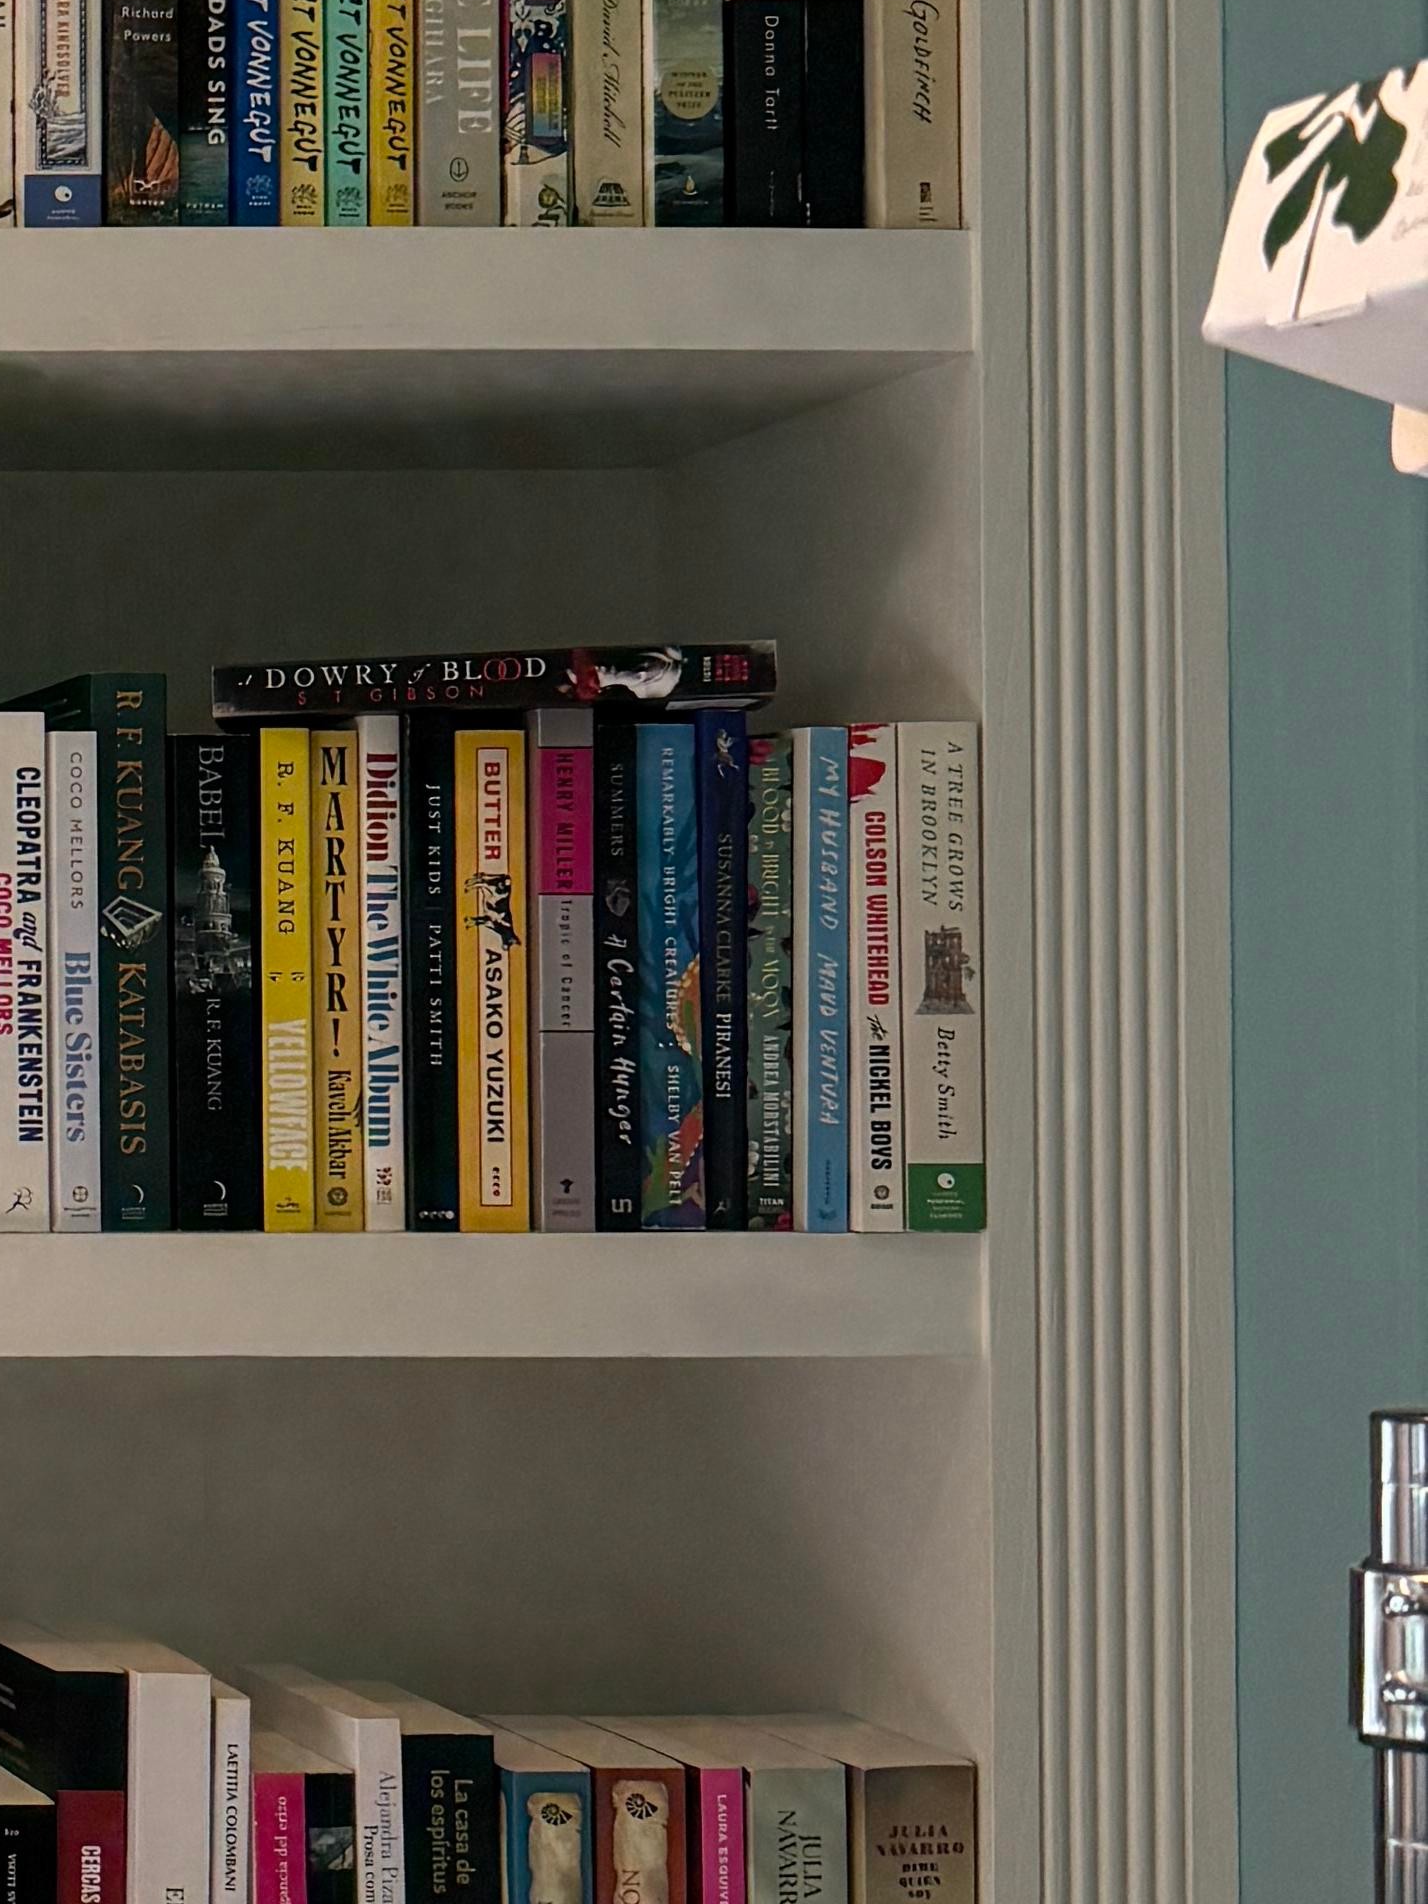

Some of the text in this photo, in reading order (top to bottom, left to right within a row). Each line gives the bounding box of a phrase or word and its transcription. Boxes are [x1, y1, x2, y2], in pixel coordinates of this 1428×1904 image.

[764, 15, 779, 77] Donna
[208, 80, 226, 146] SING
[766, 88, 780, 131] Tartt
[13, 767, 44, 1142] CLEOPATRA and FRANKENSTEIN
[484, 761, 504, 1143] BUTTER ASAKO YUZUKI
[119, 963, 146, 1155] KATABASIS
[80, 1845, 101, 1904] CERCAS
[802, 1834, 821, 1898] JULIA
